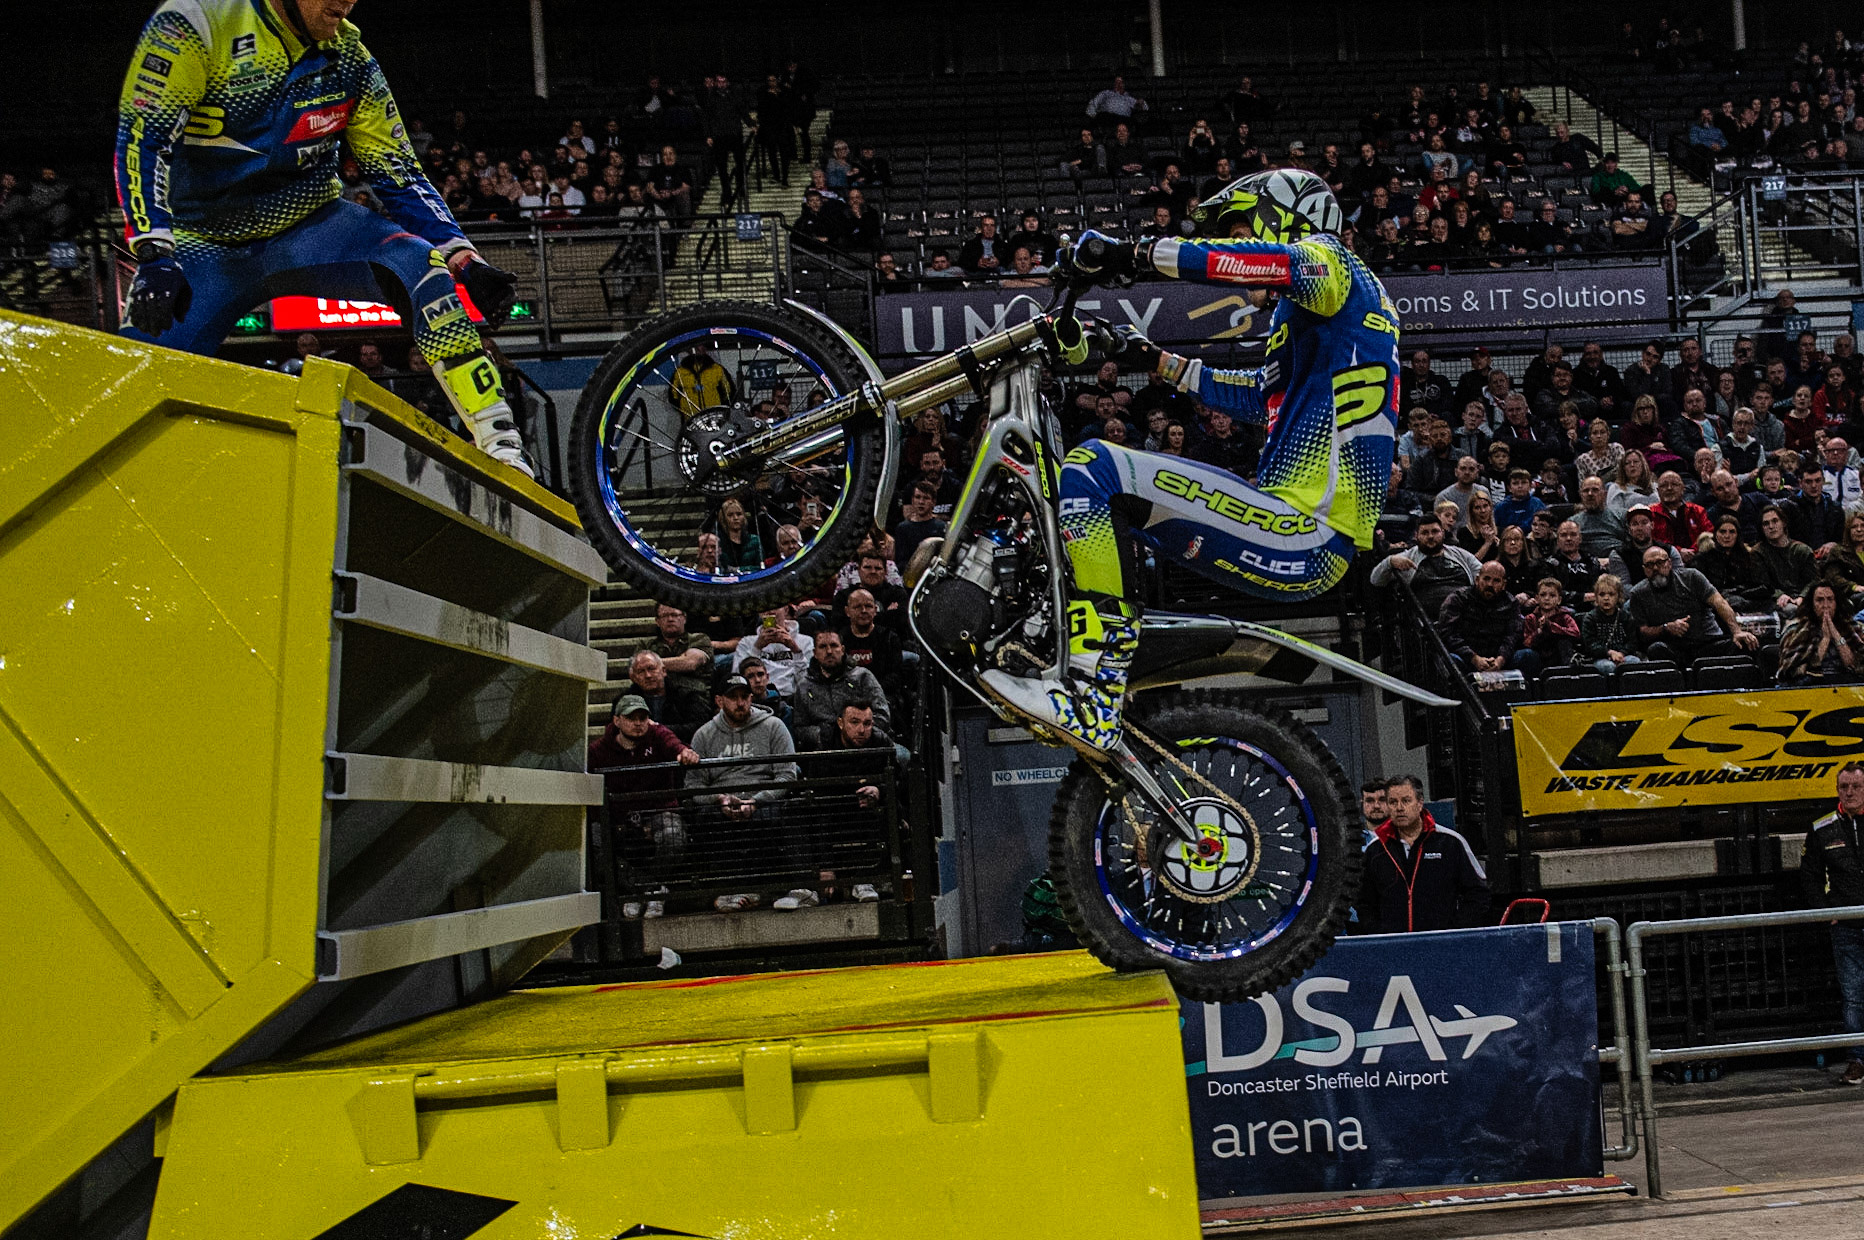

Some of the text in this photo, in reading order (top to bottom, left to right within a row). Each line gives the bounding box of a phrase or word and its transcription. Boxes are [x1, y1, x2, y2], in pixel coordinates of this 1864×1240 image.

[1764, 181, 1785, 191] 217
[738, 220, 760, 230] 217
[1214, 254, 1288, 276] Milwaukee
[1395, 285, 1646, 314] oms & IT Solutions
[1035, 441, 1051, 499] SHERCO
[1153, 469, 1318, 536] SHERCO
[1213, 558, 1323, 593] SHERCO
[1239, 550, 1306, 576] CLICE
[995, 769, 1070, 782] NO WHEELCH
[1544, 774, 1637, 794] WASTE
[1638, 762, 1839, 789] MANAGEMENT
[1203, 974, 1448, 1074] DSA
[1207, 1069, 1449, 1098] Doncaster Sheffield Airport
[1211, 1115, 1368, 1159] arena
